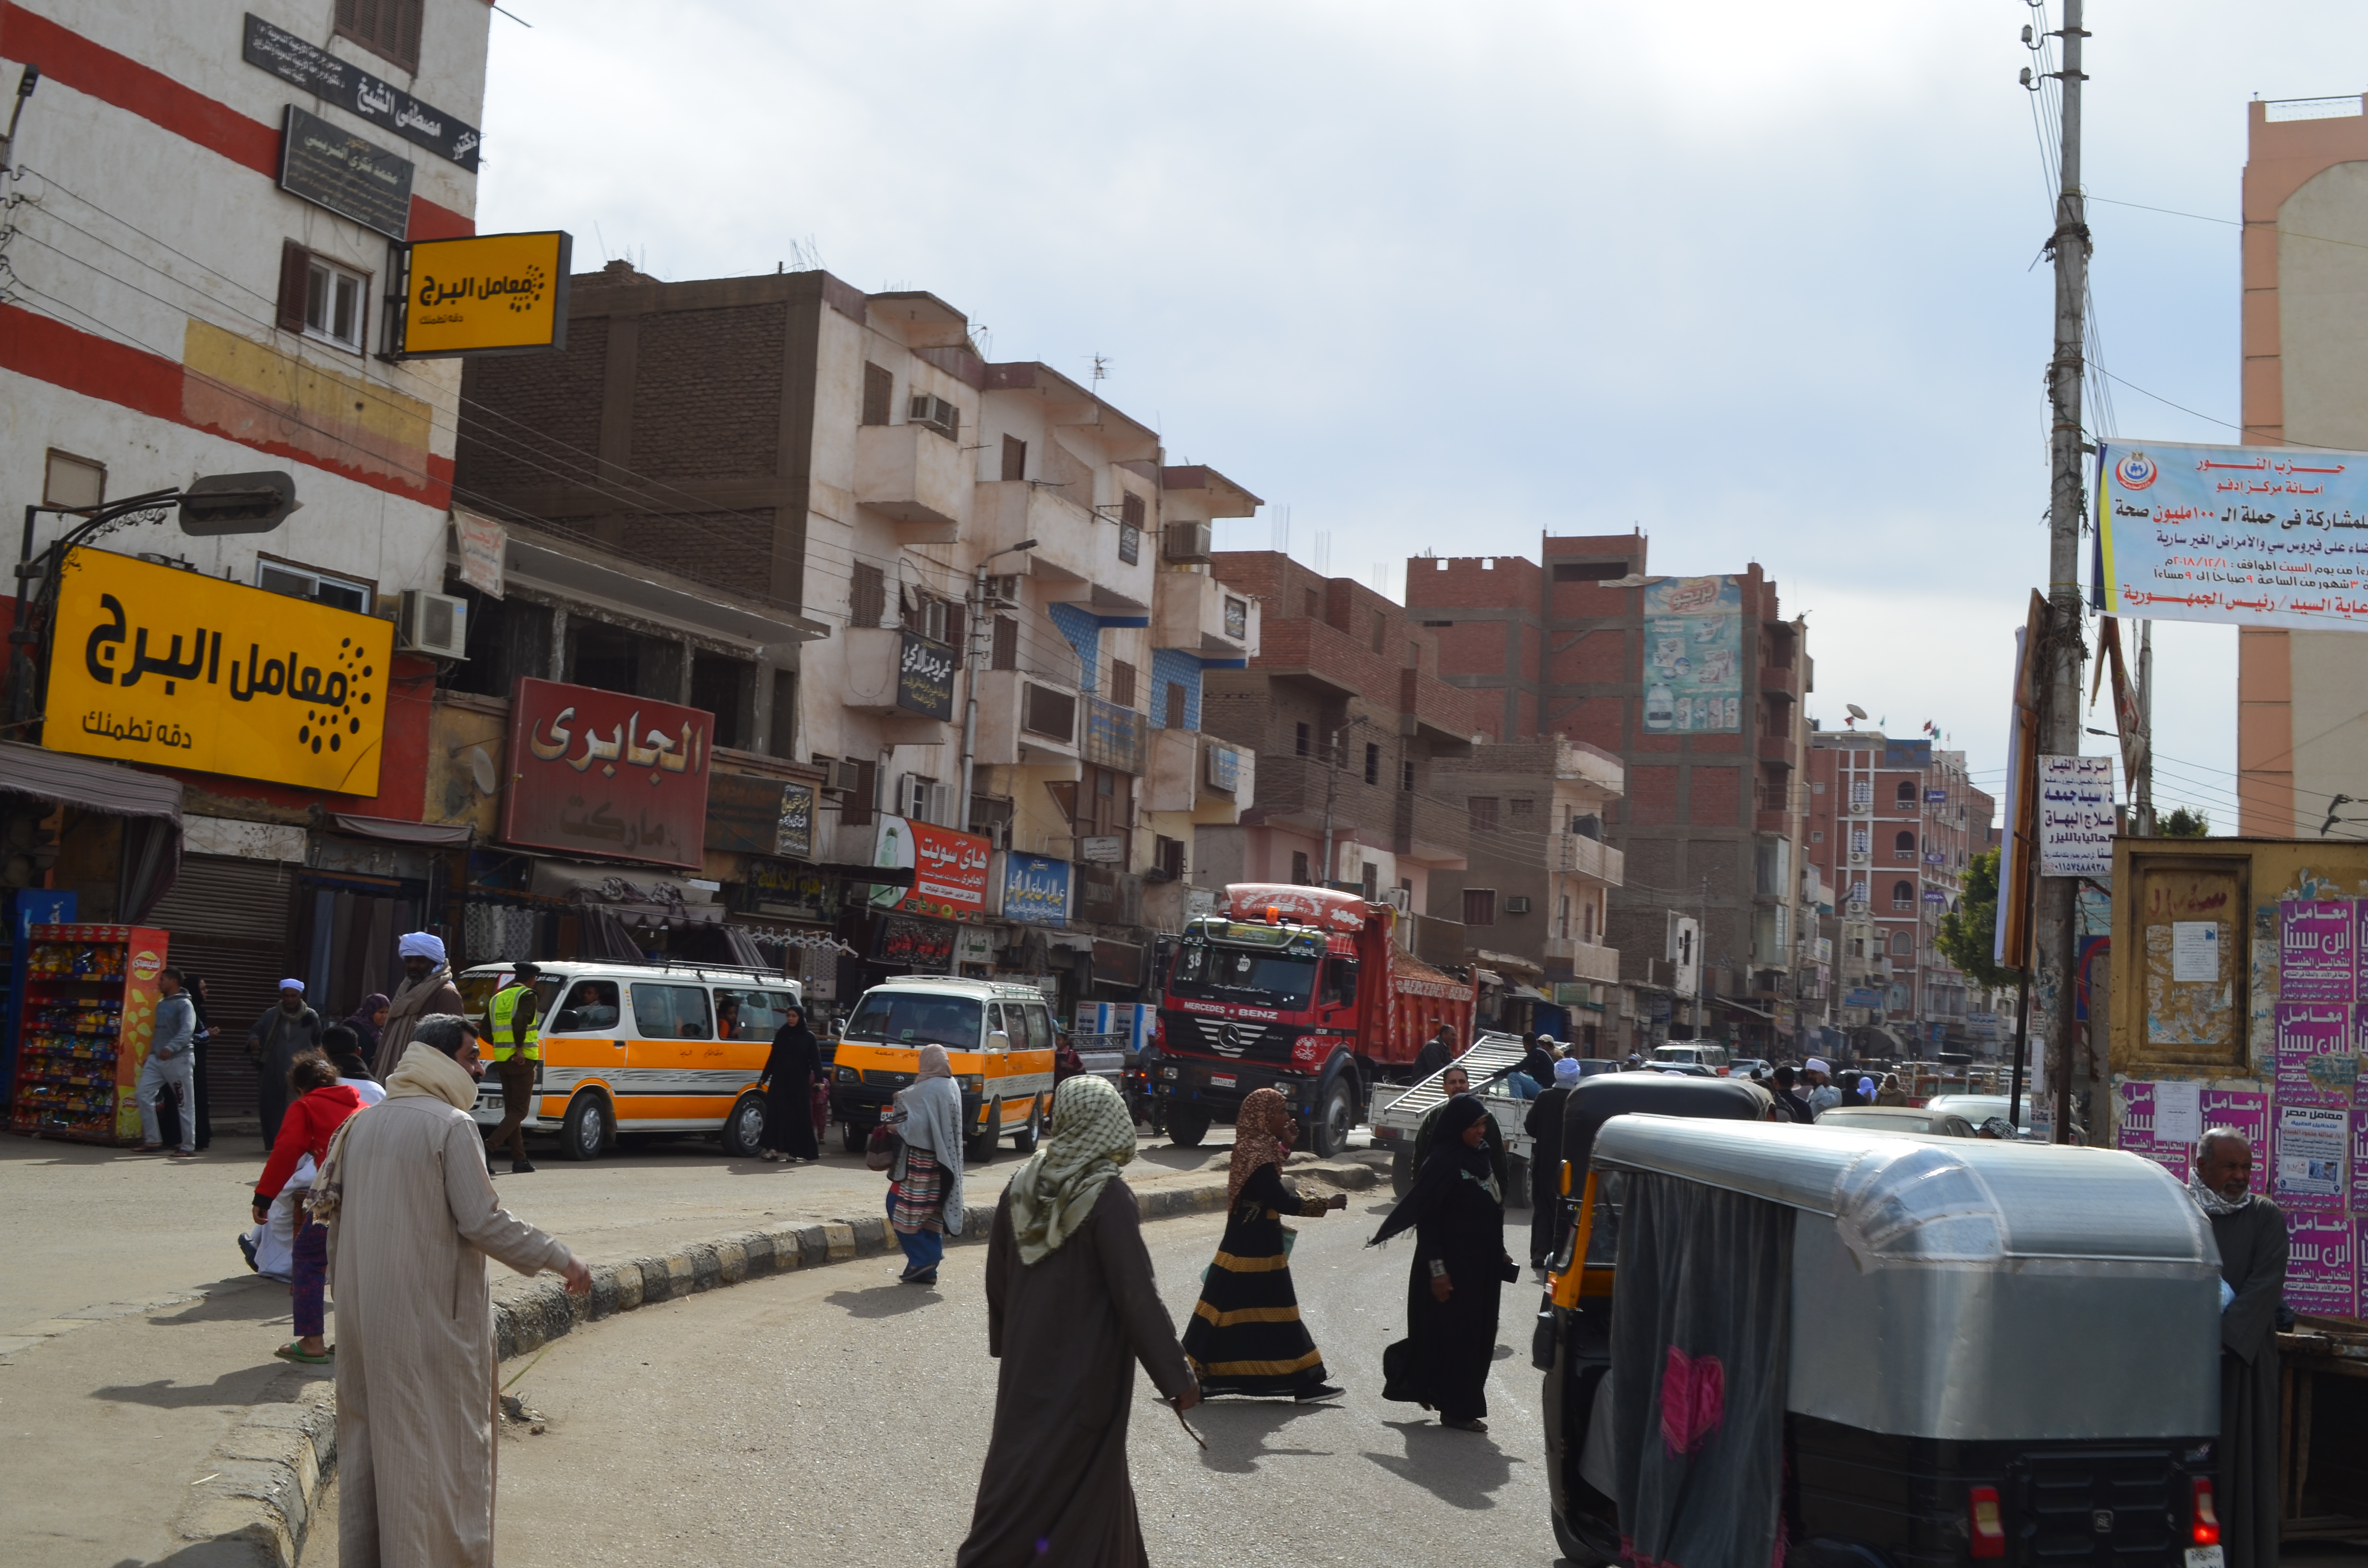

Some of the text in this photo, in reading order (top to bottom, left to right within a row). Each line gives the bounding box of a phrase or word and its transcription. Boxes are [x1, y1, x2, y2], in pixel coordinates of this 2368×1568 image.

[357, 76, 478, 160] دكتور مصطفى الشيخ
[373, 165, 398, 185] محمد
[419, 275, 534, 306] معامل البرج
[2215, 478, 2243, 495] إدفو
[2245, 480, 2282, 496] مركز
[2115, 498, 2149, 518] صحة
[2241, 505, 2276, 525] حملة
[2306, 508, 2368, 531] لمشاركة
[2156, 530, 2187, 547] سارية
[2189, 533, 2215, 549] الغير
[2216, 533, 2266, 551] والأمراض
[2286, 539, 2322, 555] فيروس
[2236, 559, 2353, 577] من يوم السبت الموافق
[2257, 576, 2297, 587] الساعة
[2299, 578, 2316, 588] من
[2123, 584, 2222, 610] الجمهورية
[2225, 592, 2275, 611] رئيس
[2290, 596, 2331, 615] السيد
[2334, 596, 2368, 619] عاية
[86, 593, 348, 708] معامل البرج
[83, 710, 152, 743] تطمنك
[530, 706, 704, 786] الجابرى
[2048, 759, 2108, 774] مركز النيل
[2078, 788, 2100, 807] سيد
[561, 794, 666, 852] ماركت
[2044, 809, 2114, 829] علاج البهاق
[920, 837, 958, 869] سويت
[2287, 903, 2347, 923] معامل
[2284, 920, 2350, 955] ابن سينا
[1188, 952, 1201, 969] 38
[2284, 955, 2350, 969] للتحاليل الطبية
[1183, 1001, 1279, 1019] MERCEDES BENZ
[2282, 1006, 2343, 1026] معامل
[2279, 1025, 2313, 1057] سينا
[2126, 1085, 2156, 1105] امل
[2202, 1092, 2262, 1113] معامل
[2285, 1109, 2343, 1120] معامل مصر
[2122, 1137, 2151, 1152] الطبية
[2286, 1213, 2348, 1234] معامل
[2287, 1233, 2351, 1268] ابن سين
[2315, 1270, 2351, 1283] للتحاليل
